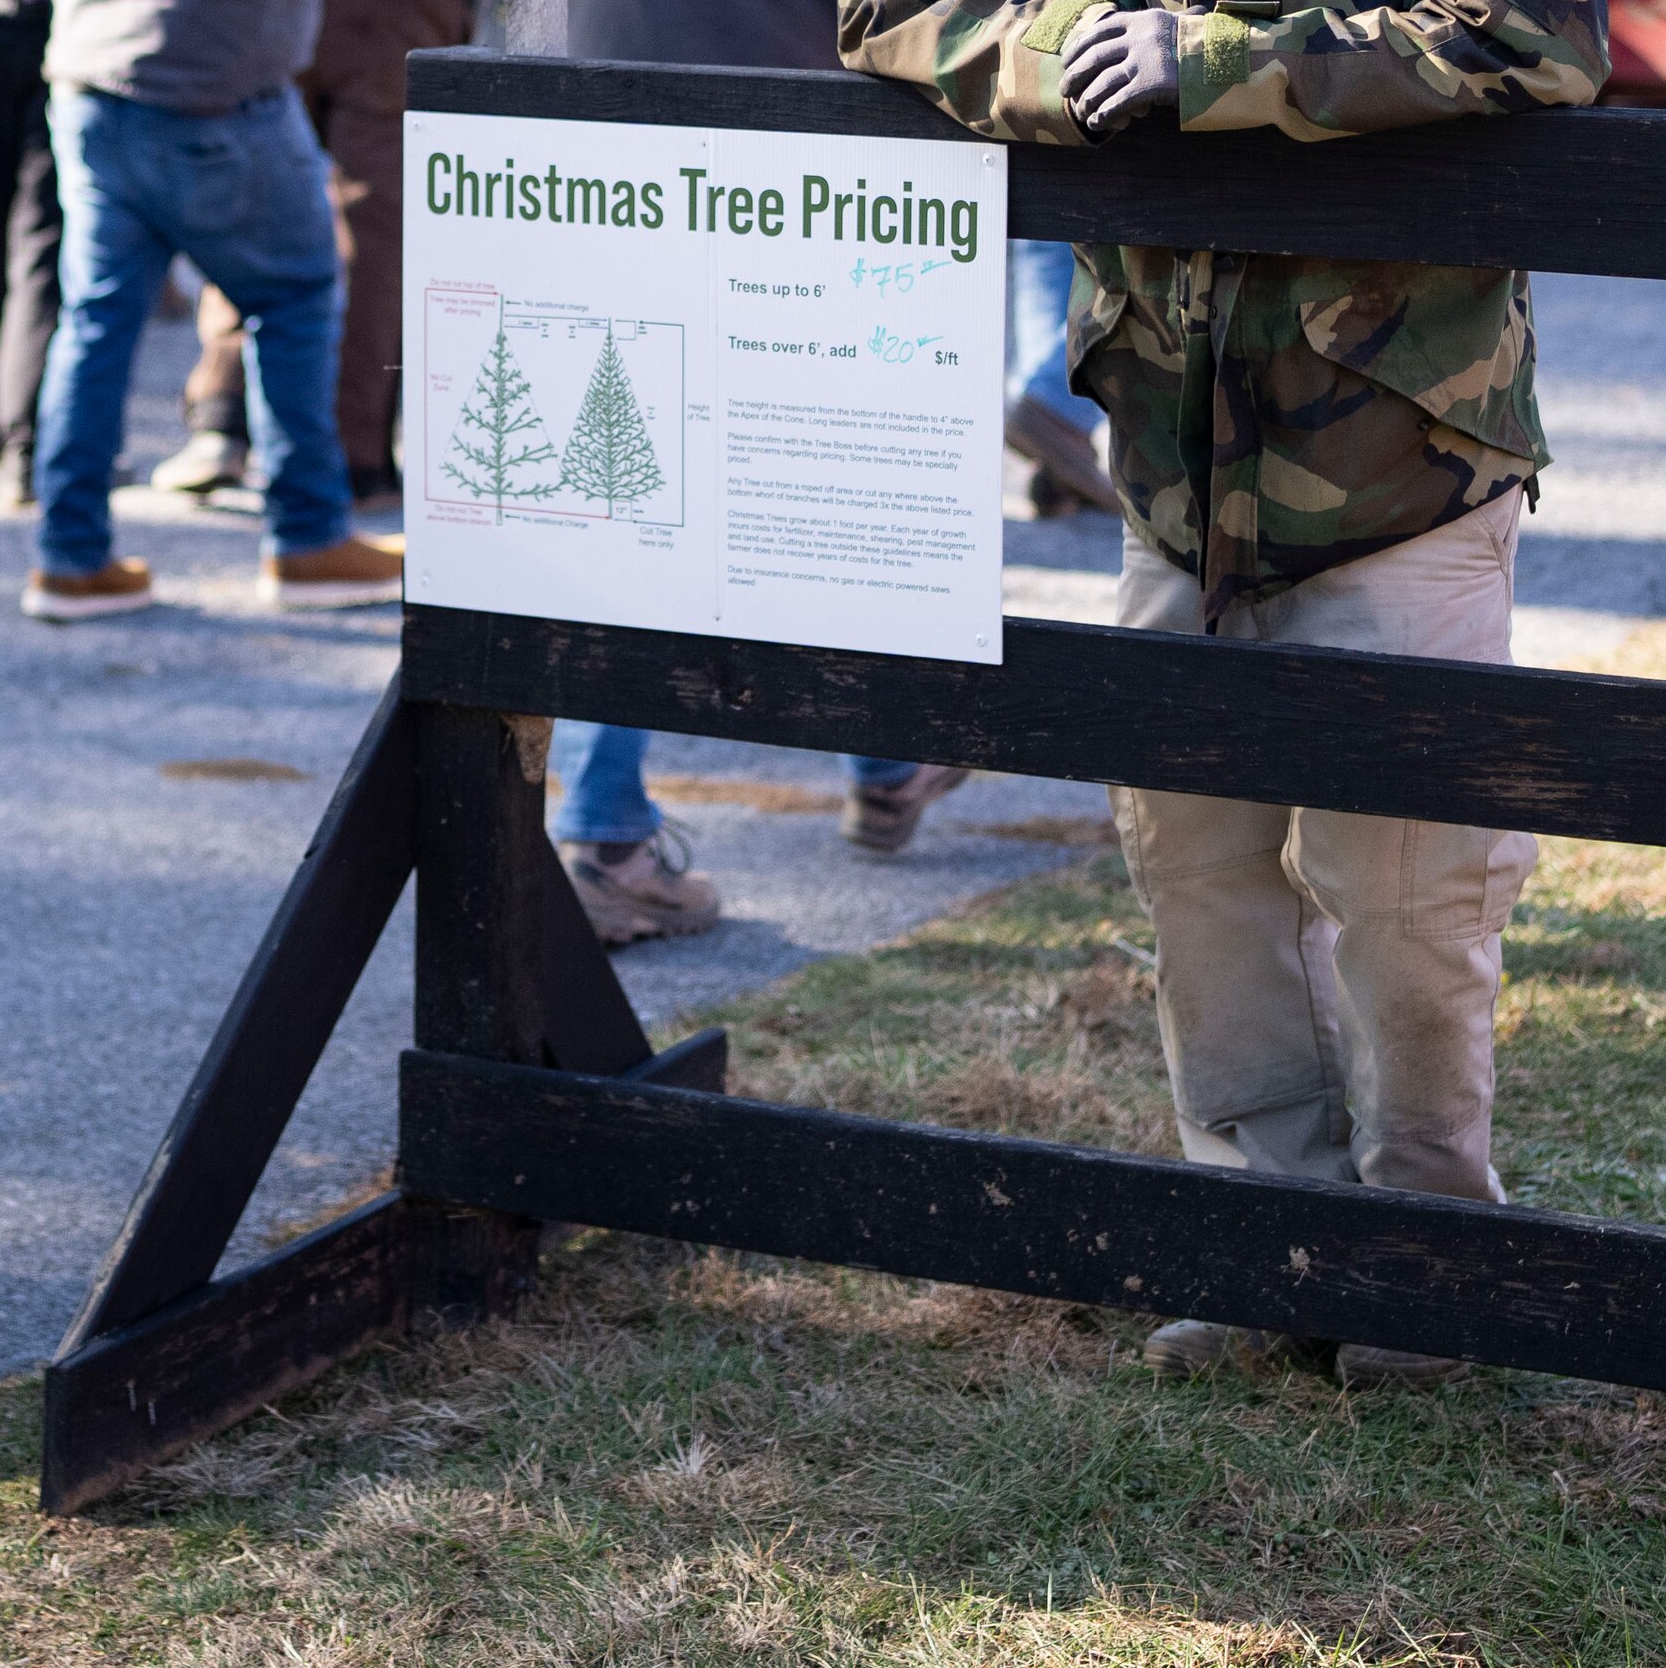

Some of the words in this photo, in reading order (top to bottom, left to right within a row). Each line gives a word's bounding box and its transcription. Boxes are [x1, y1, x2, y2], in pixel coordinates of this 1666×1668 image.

[428, 153, 663, 229] Christmas
[680, 168, 783, 236] Tree
[803, 175, 977, 262] Pricing
[729, 279, 767, 293] Trees
[773, 286, 790, 298] up
[795, 284, 808, 296] to
[814, 285, 825, 297] 6'
[729, 336, 766, 351] Trees
[772, 343, 803, 353] over
[809, 342, 824, 357] 6',
[830, 345, 856, 357] add
[936, 351, 958, 365] $/ft
